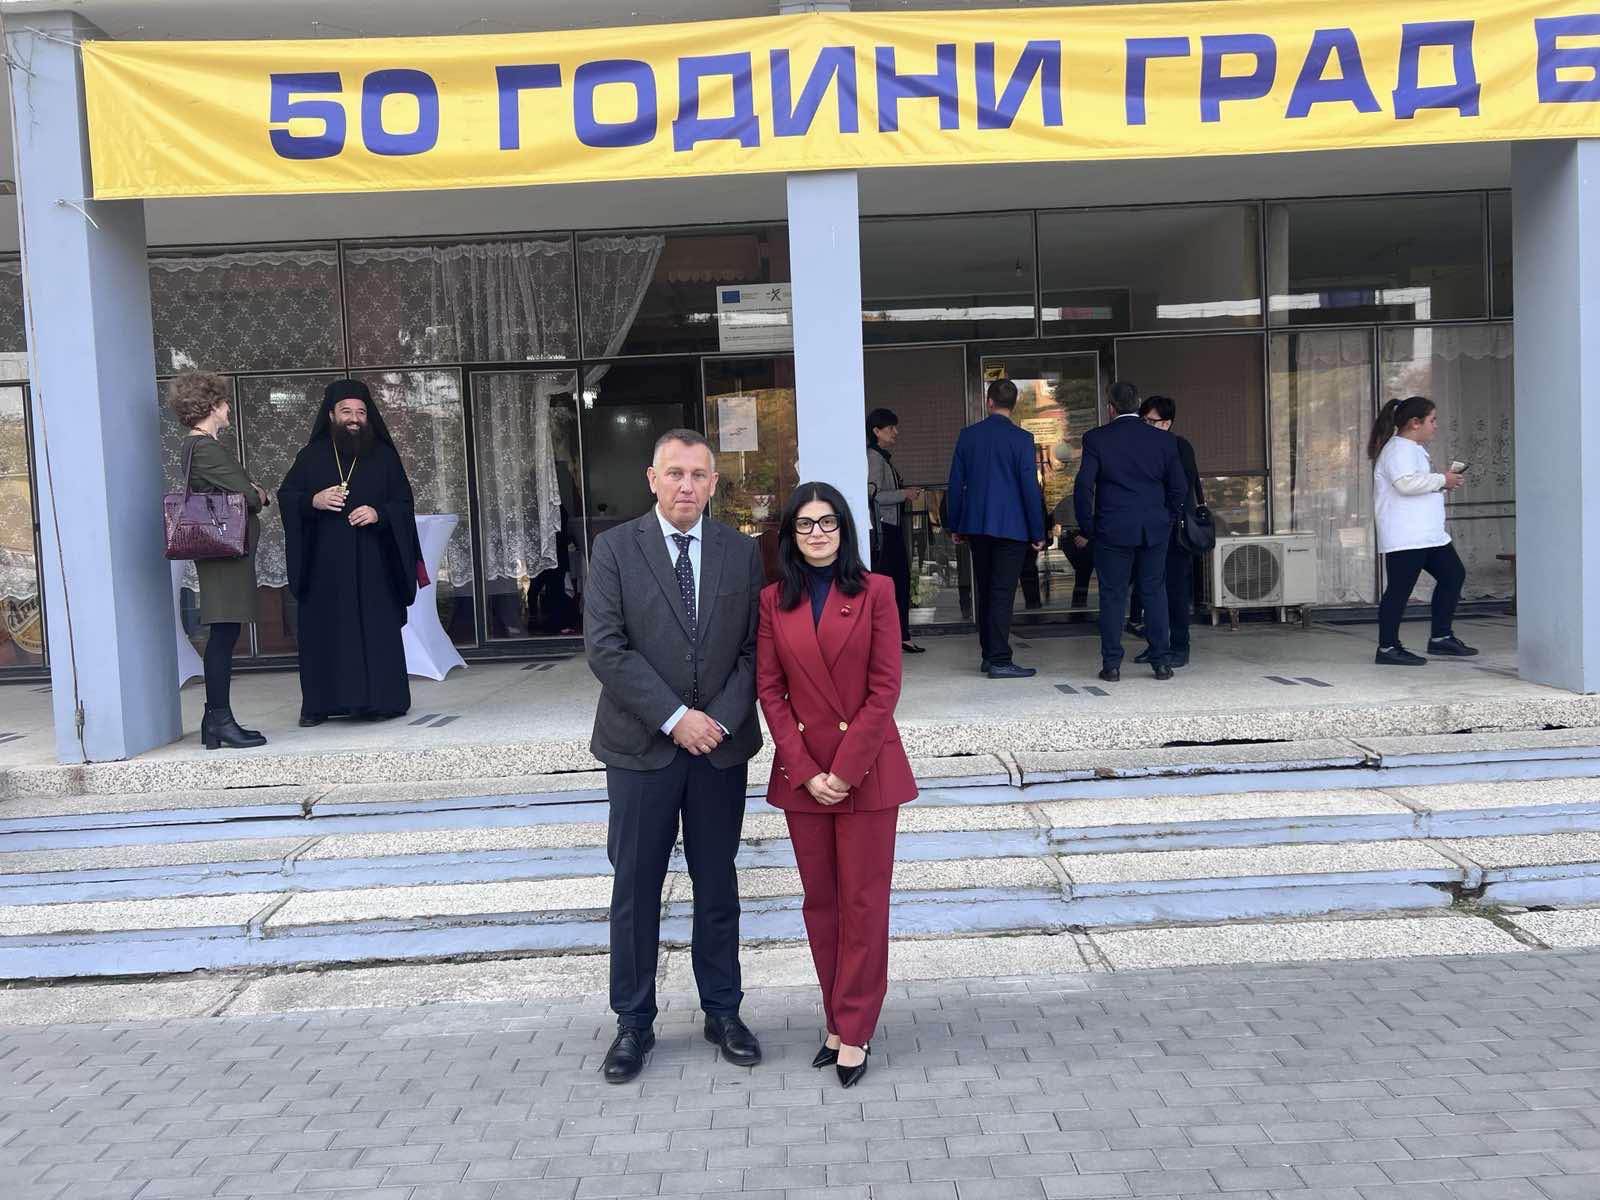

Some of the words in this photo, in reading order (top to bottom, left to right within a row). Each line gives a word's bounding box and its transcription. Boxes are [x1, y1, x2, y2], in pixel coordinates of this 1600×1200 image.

[270, 70, 439, 159] 50
[496, 40, 1063, 152] ГОДИНИ
[1125, 21, 1479, 125] ГРАД
